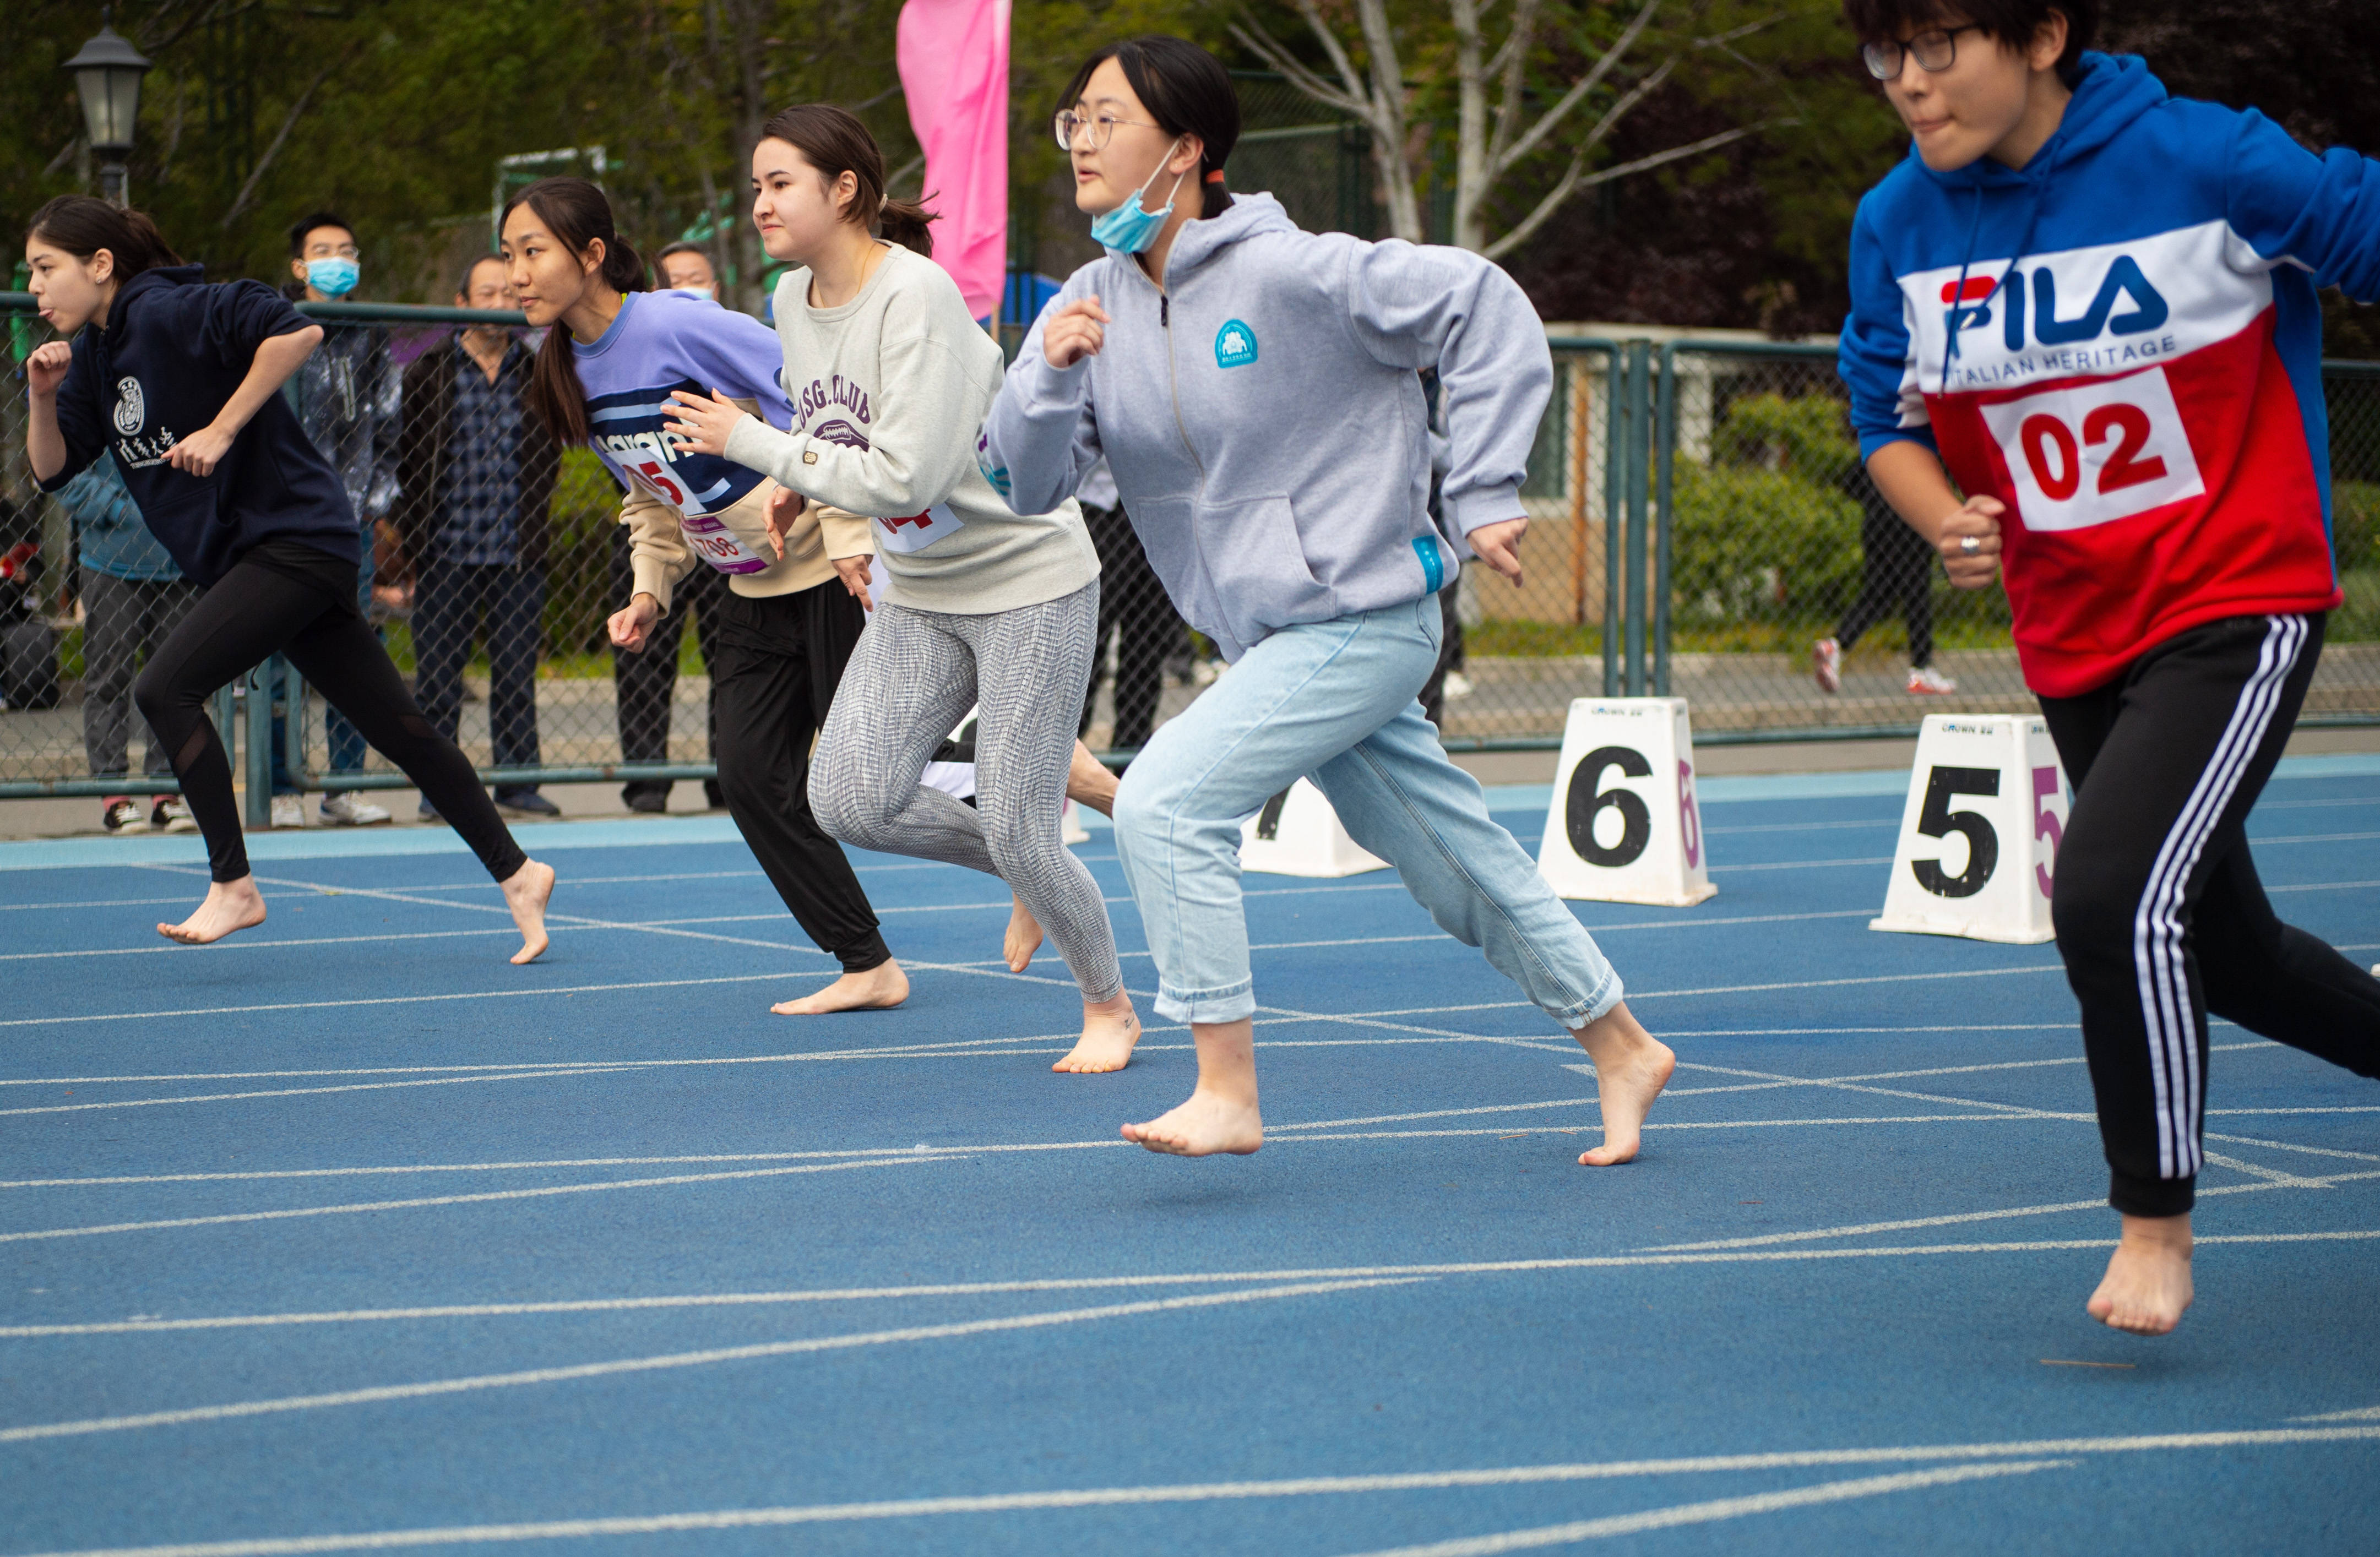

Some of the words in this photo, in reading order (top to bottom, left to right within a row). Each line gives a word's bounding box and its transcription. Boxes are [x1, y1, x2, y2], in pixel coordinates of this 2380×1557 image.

[1940, 254, 2169, 359] FILA
[2042, 335, 2176, 371] HERITAGE
[2020, 402, 2168, 502] 02
[688, 537, 739, 558] 1708
[1565, 745, 1653, 868] 6
[1677, 759, 1699, 870] 6
[1910, 764, 2001, 899] 5
[2032, 766, 2063, 899] 5
